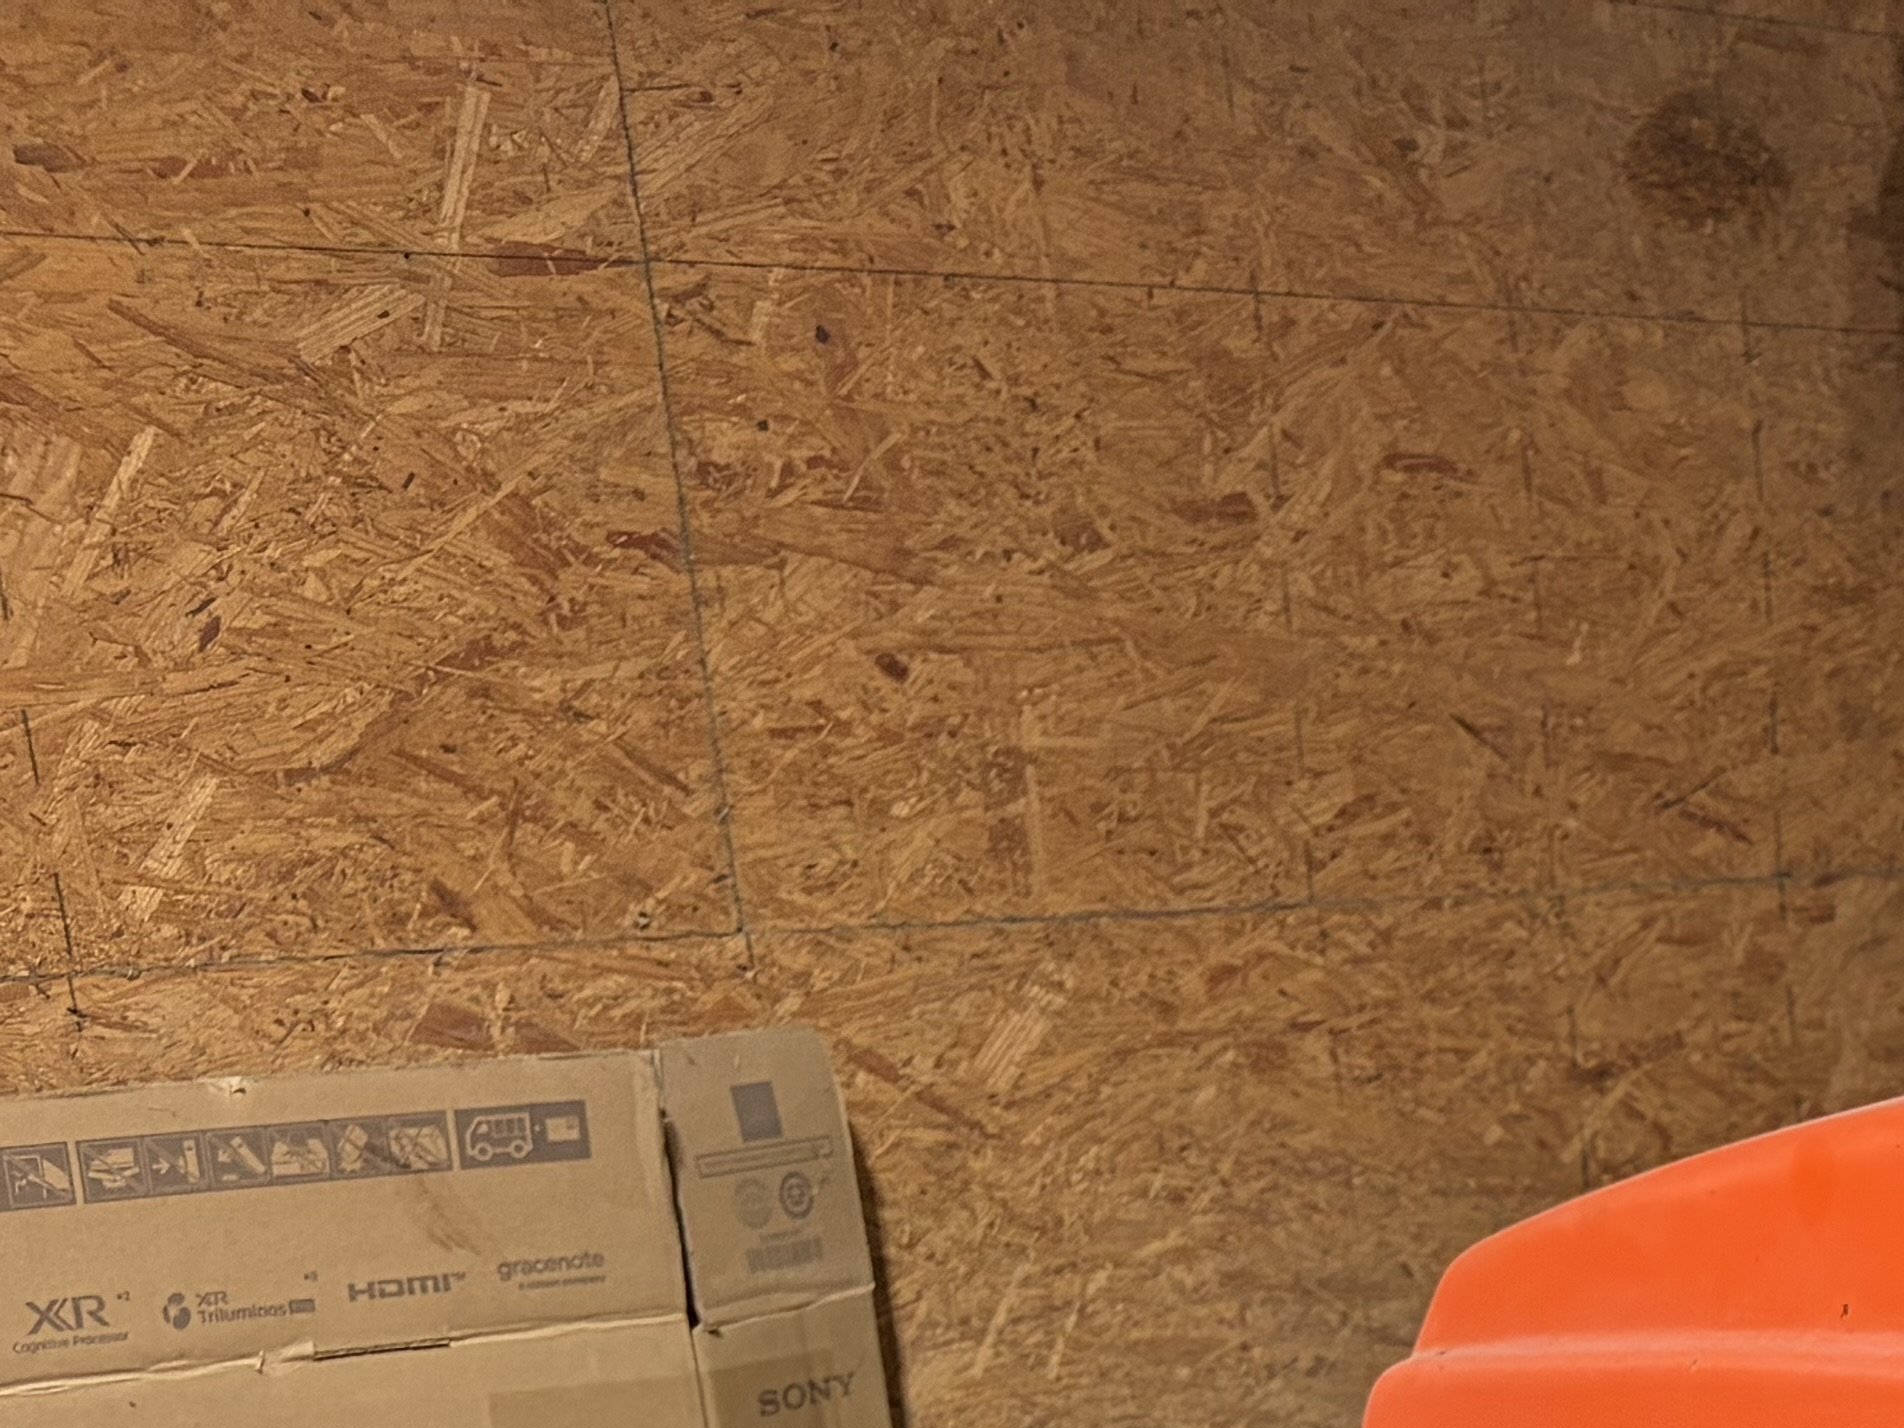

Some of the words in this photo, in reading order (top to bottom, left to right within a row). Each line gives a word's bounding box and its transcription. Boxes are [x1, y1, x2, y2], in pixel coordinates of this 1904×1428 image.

[498, 1251, 605, 1281] gracenote
[25, 1294, 110, 1336] XR
[757, 1371, 854, 1417] SONY
